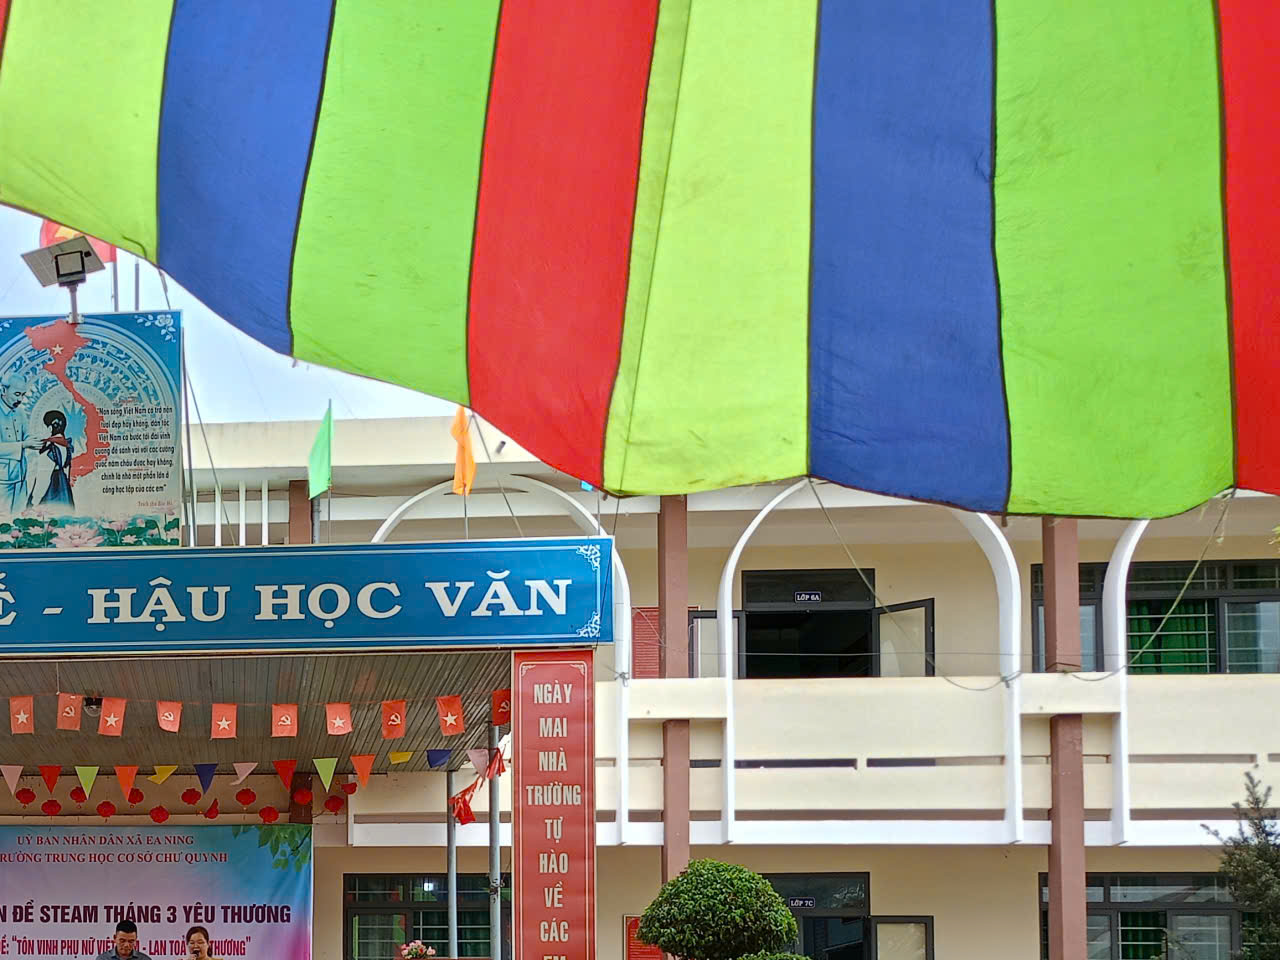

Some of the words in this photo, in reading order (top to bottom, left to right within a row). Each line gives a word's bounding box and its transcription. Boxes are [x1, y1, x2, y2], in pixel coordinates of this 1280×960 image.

[87, 577, 231, 632] HẬU
[254, 582, 402, 629] HỌC
[425, 570, 572, 618] VĂN
[534, 680, 572, 704] NGÀY
[539, 718, 567, 737] MAI
[538, 748, 567, 771] NHÀ
[525, 781, 581, 806] TRƯỜNG
[36, 836, 60, 845] BAN
[62, 834, 96, 845] NHÂN
[100, 833, 123, 845] DÂN
[126, 834, 142, 845] XÃ
[146, 836, 161, 845] EA
[164, 836, 194, 845] NING
[545, 816, 563, 843] TỰ
[44, 853, 85, 862] TRUNG
[88, 853, 114, 864] HỌC
[117, 852, 135, 862] CƠ
[137, 850, 154, 862] SỞ
[156, 852, 183, 862] CHƯ
[185, 853, 227, 864] QUYNH
[539, 849, 568, 873] HÀO
[544, 881, 563, 908] VỀ
[12, 899, 34, 923] ĐỀ
[40, 905, 98, 923] STEAM
[104, 902, 161, 923] THÁNG
[166, 905, 177, 923] 3
[182, 902, 215, 923] YÊU
[221, 904, 291, 923] THƯƠNG
[540, 918, 569, 942] CÁC
[37, 940, 58, 955] VINH
[61, 940, 79, 958] PHỤ
[82, 936, 95, 955] NỮ
[149, 940, 166, 955] LAN
[169, 935, 186, 955] TOẢ
